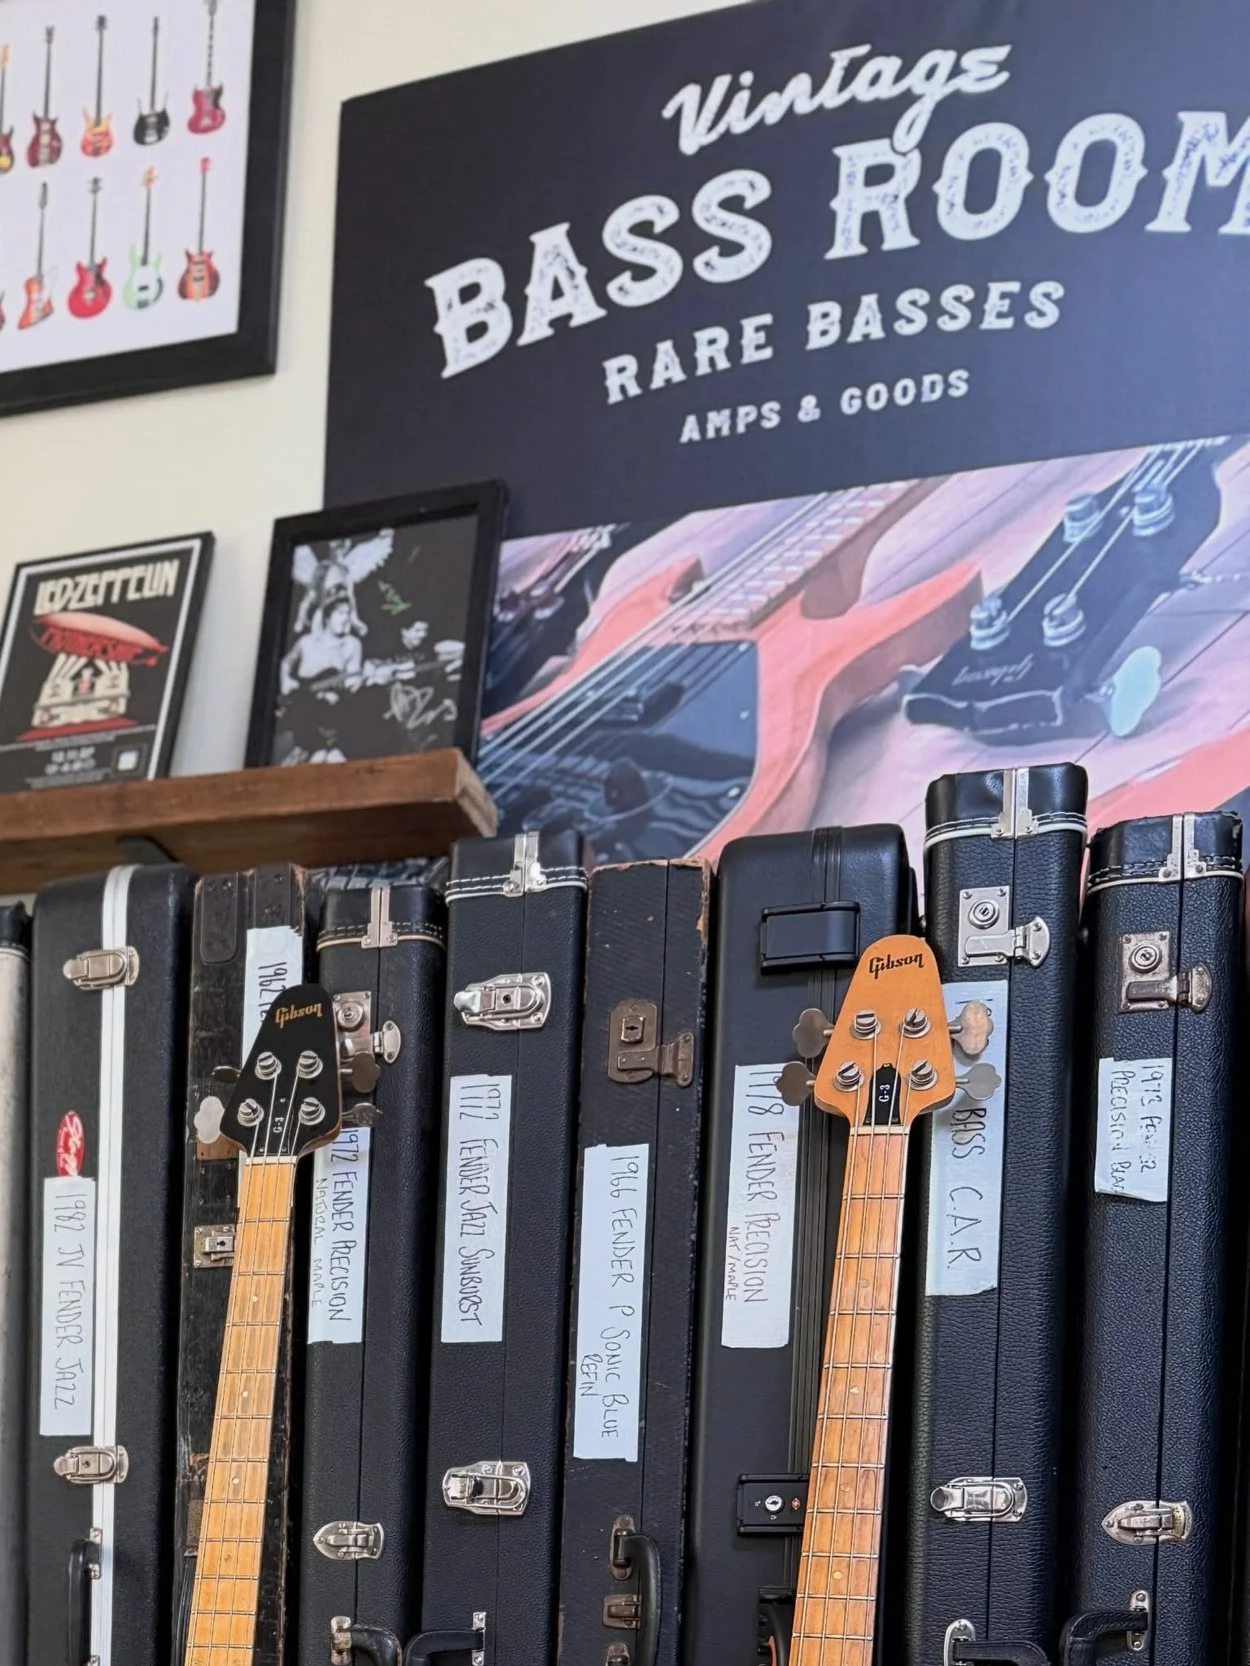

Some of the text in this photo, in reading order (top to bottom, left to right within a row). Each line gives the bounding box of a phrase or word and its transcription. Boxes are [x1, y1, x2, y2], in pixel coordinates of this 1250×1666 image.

[662, 43, 1012, 156] Vintage
[424, 110, 1250, 380] BASS ROOM
[603, 280, 1066, 405] RARE BASSES
[680, 369, 971, 445] AMPS & GOODS
[258, 961, 289, 999] 1962
[868, 953, 925, 980] Gibson
[274, 1002, 323, 1029] Gibson
[878, 1083, 891, 1103] G-3
[1140, 1064, 1165, 1108] 1973
[272, 1116, 285, 1134] G-3
[950, 1106, 988, 1160] BASS
[747, 1131, 785, 1202] FENDER
[310, 1177, 329, 1309] NATURAL MAPLE
[328, 1128, 360, 1322] 1972 FENDER PRECISION
[457, 1083, 502, 1327] 1972 FENDER JAZZ SUNBURST
[743, 1212, 782, 1304] PRECISION
[53, 1193, 88, 1410] 1982 JV FENDER JAZZ
[599, 1154, 641, 1439] 1966 FENDER P SONIC BLUE
[579, 1353, 604, 1398] REFIN
